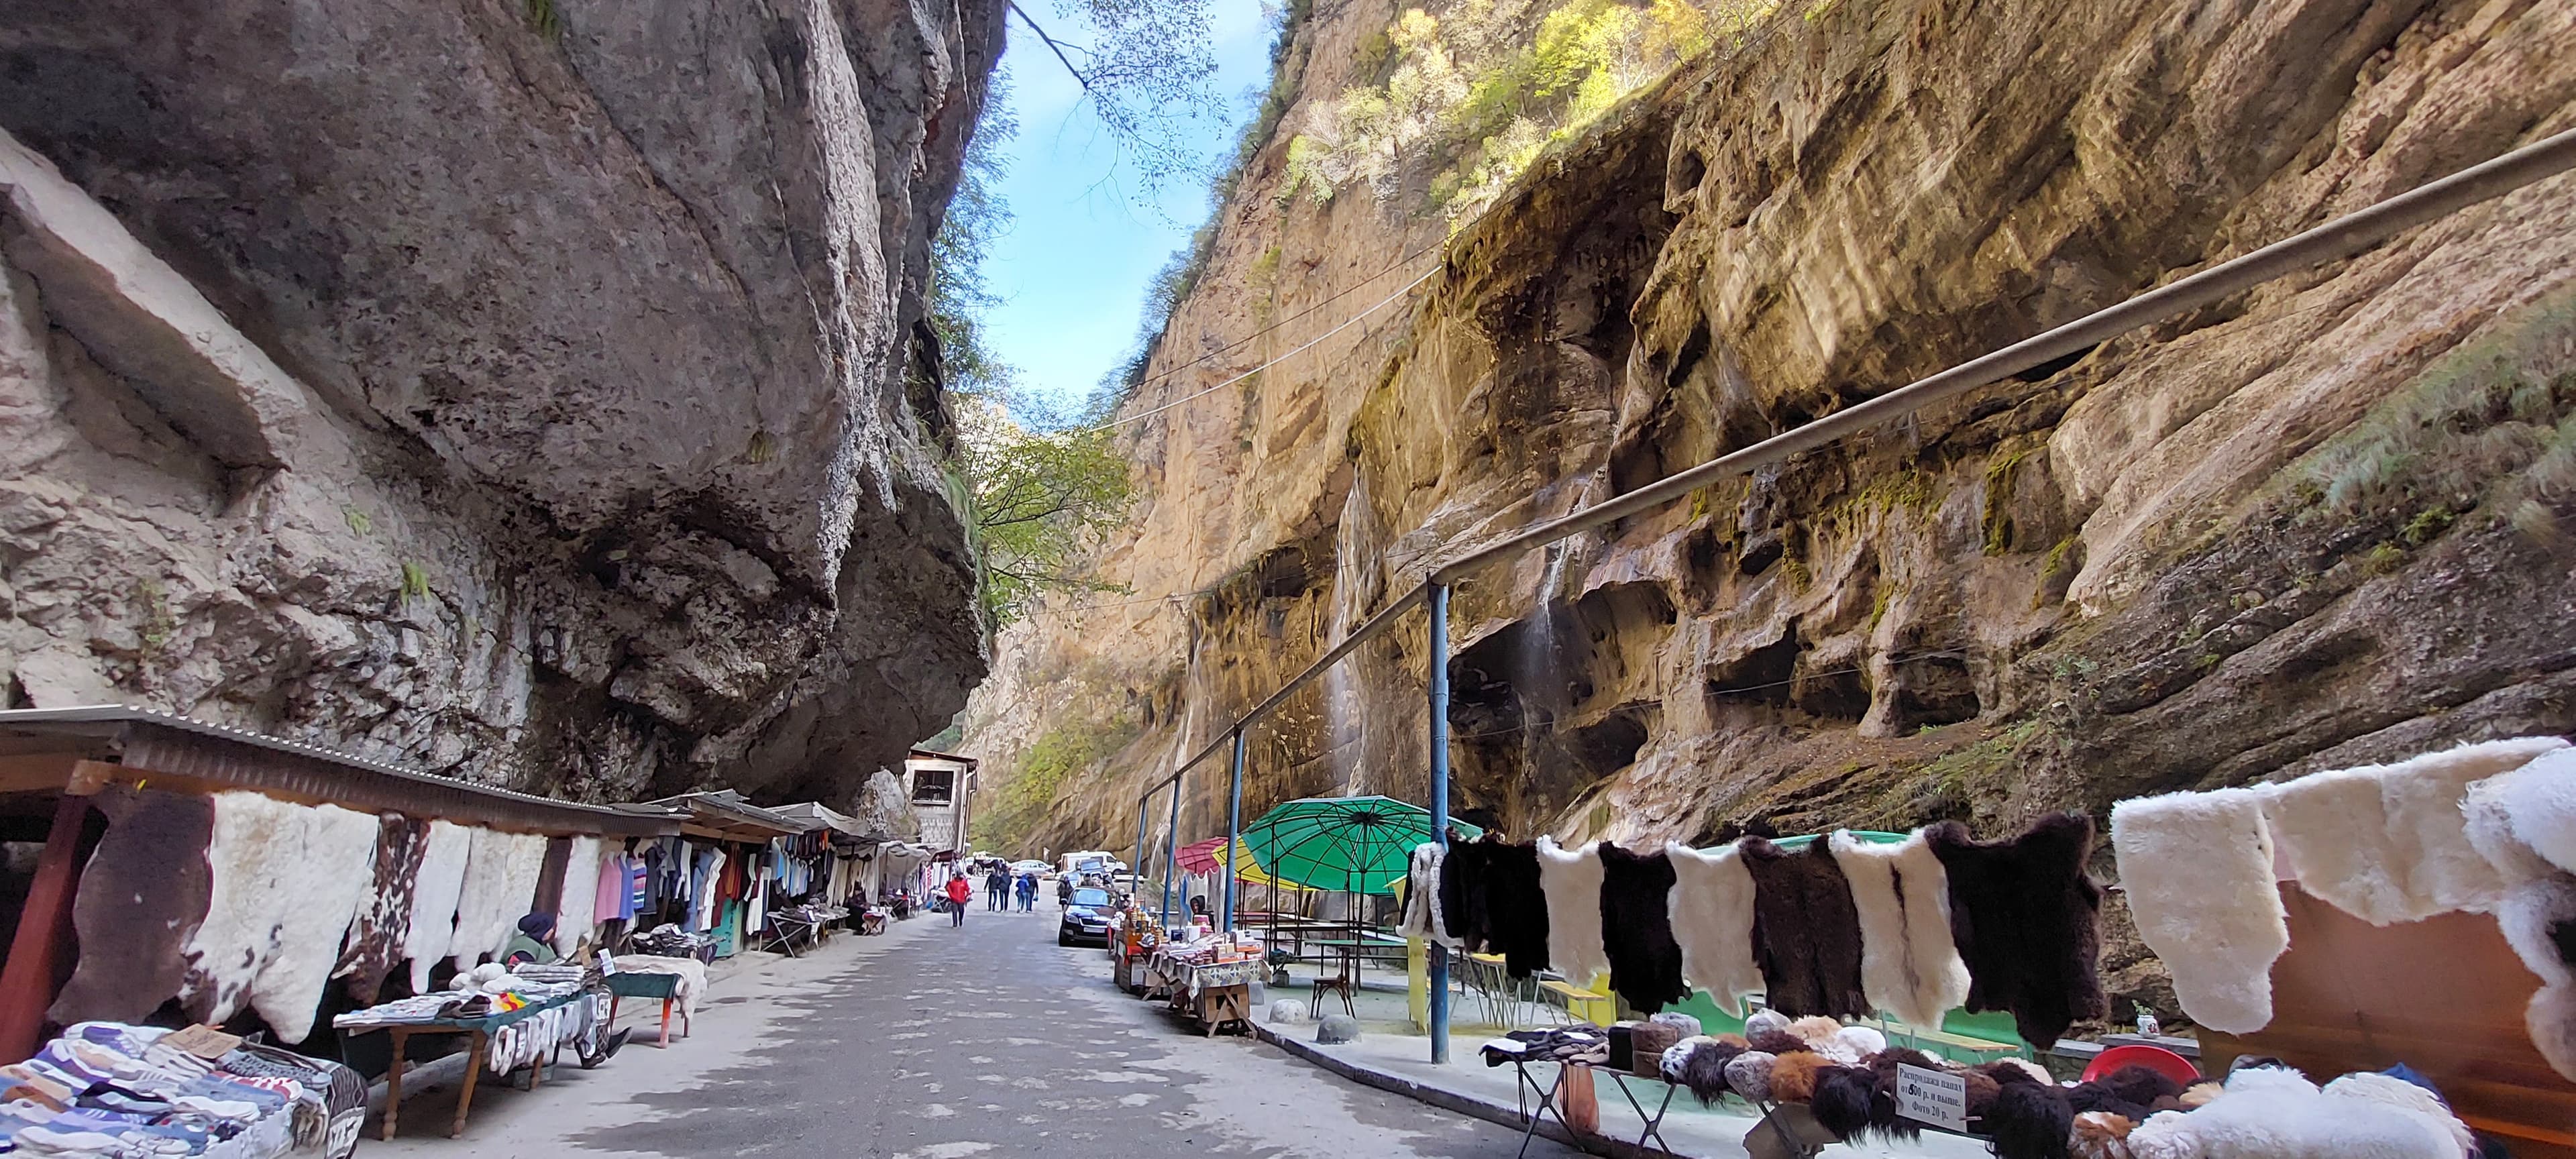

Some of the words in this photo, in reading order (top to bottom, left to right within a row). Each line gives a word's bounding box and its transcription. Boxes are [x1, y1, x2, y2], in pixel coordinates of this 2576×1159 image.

[1899, 1068, 1939, 1086] Распродажа
[1941, 1080, 1962, 1092] папах
[1923, 1091, 1929, 1101] р.
[1937, 1095, 1961, 1107] выше.
[1912, 1101, 1930, 1114] Фото
[1931, 1106, 1939, 1117] 20
[1941, 1111, 1949, 1121] р.
